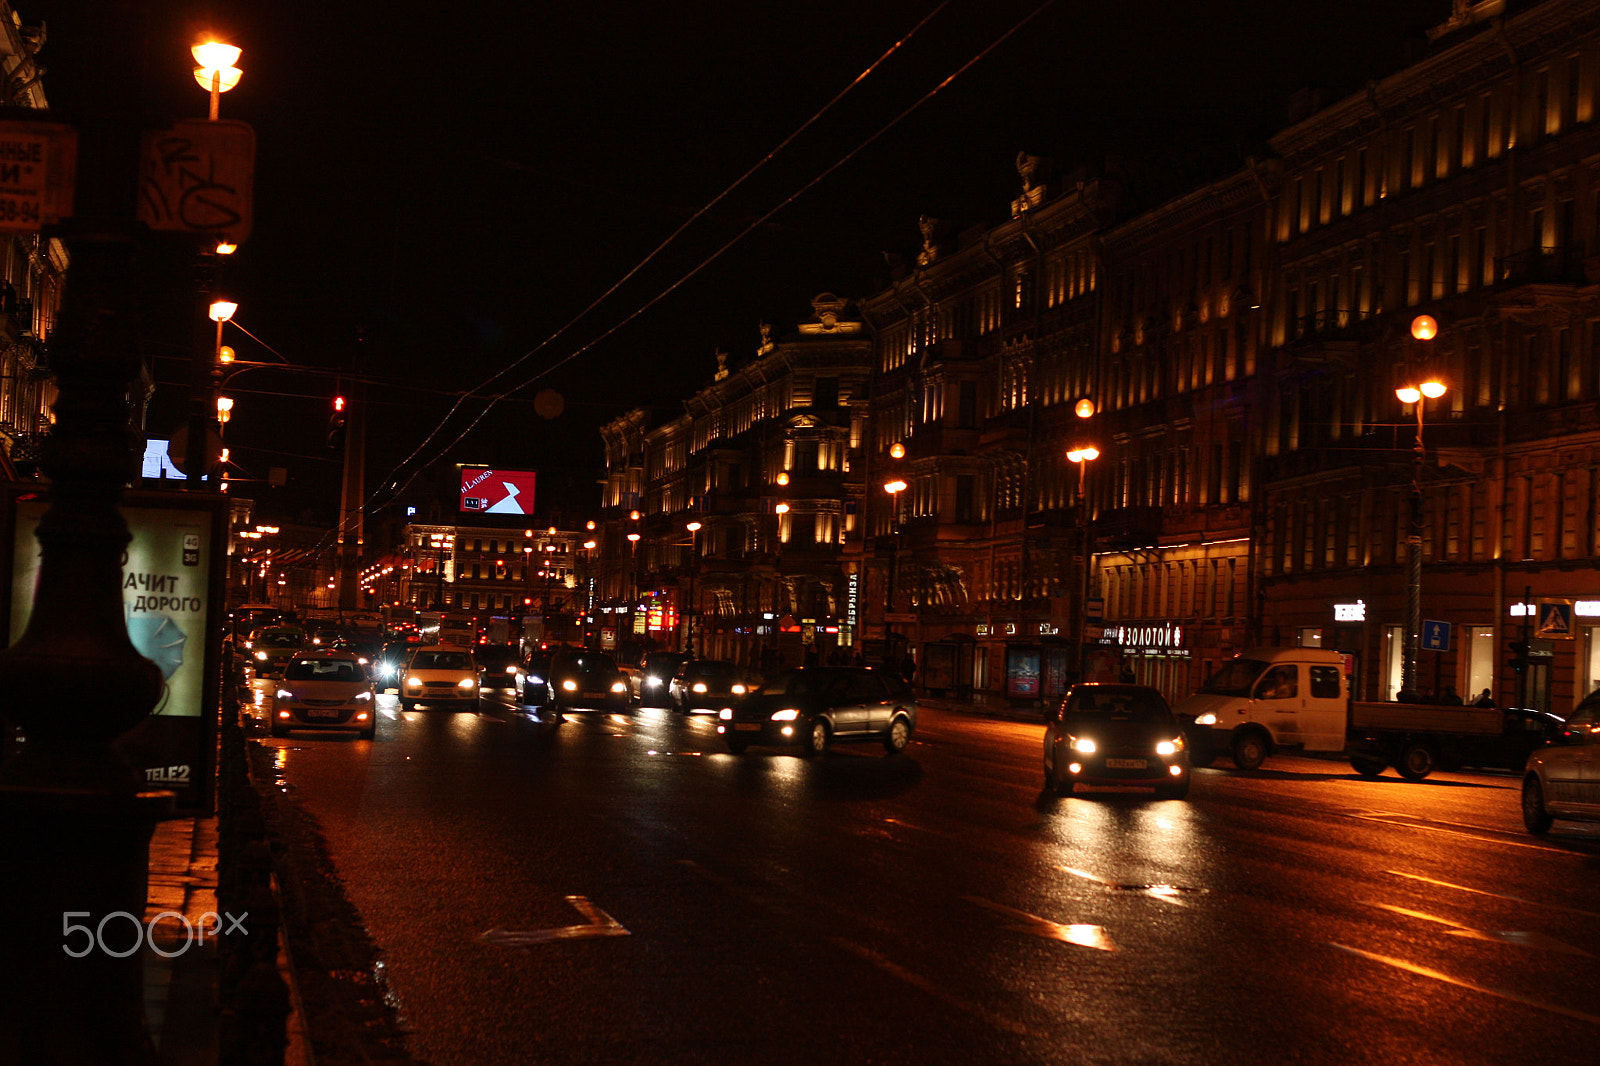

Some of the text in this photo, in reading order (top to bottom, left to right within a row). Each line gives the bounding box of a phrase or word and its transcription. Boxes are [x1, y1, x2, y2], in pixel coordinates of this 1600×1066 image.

[464, 471, 493, 489] LAUREN
[185, 537, 198, 547] 4G
[184, 553, 197, 562] 3G
[133, 596, 201, 612] ДОРОГО
[1126, 622, 1171, 646] ЗОЛОТОЙ
[145, 765, 191, 783] TELE2
